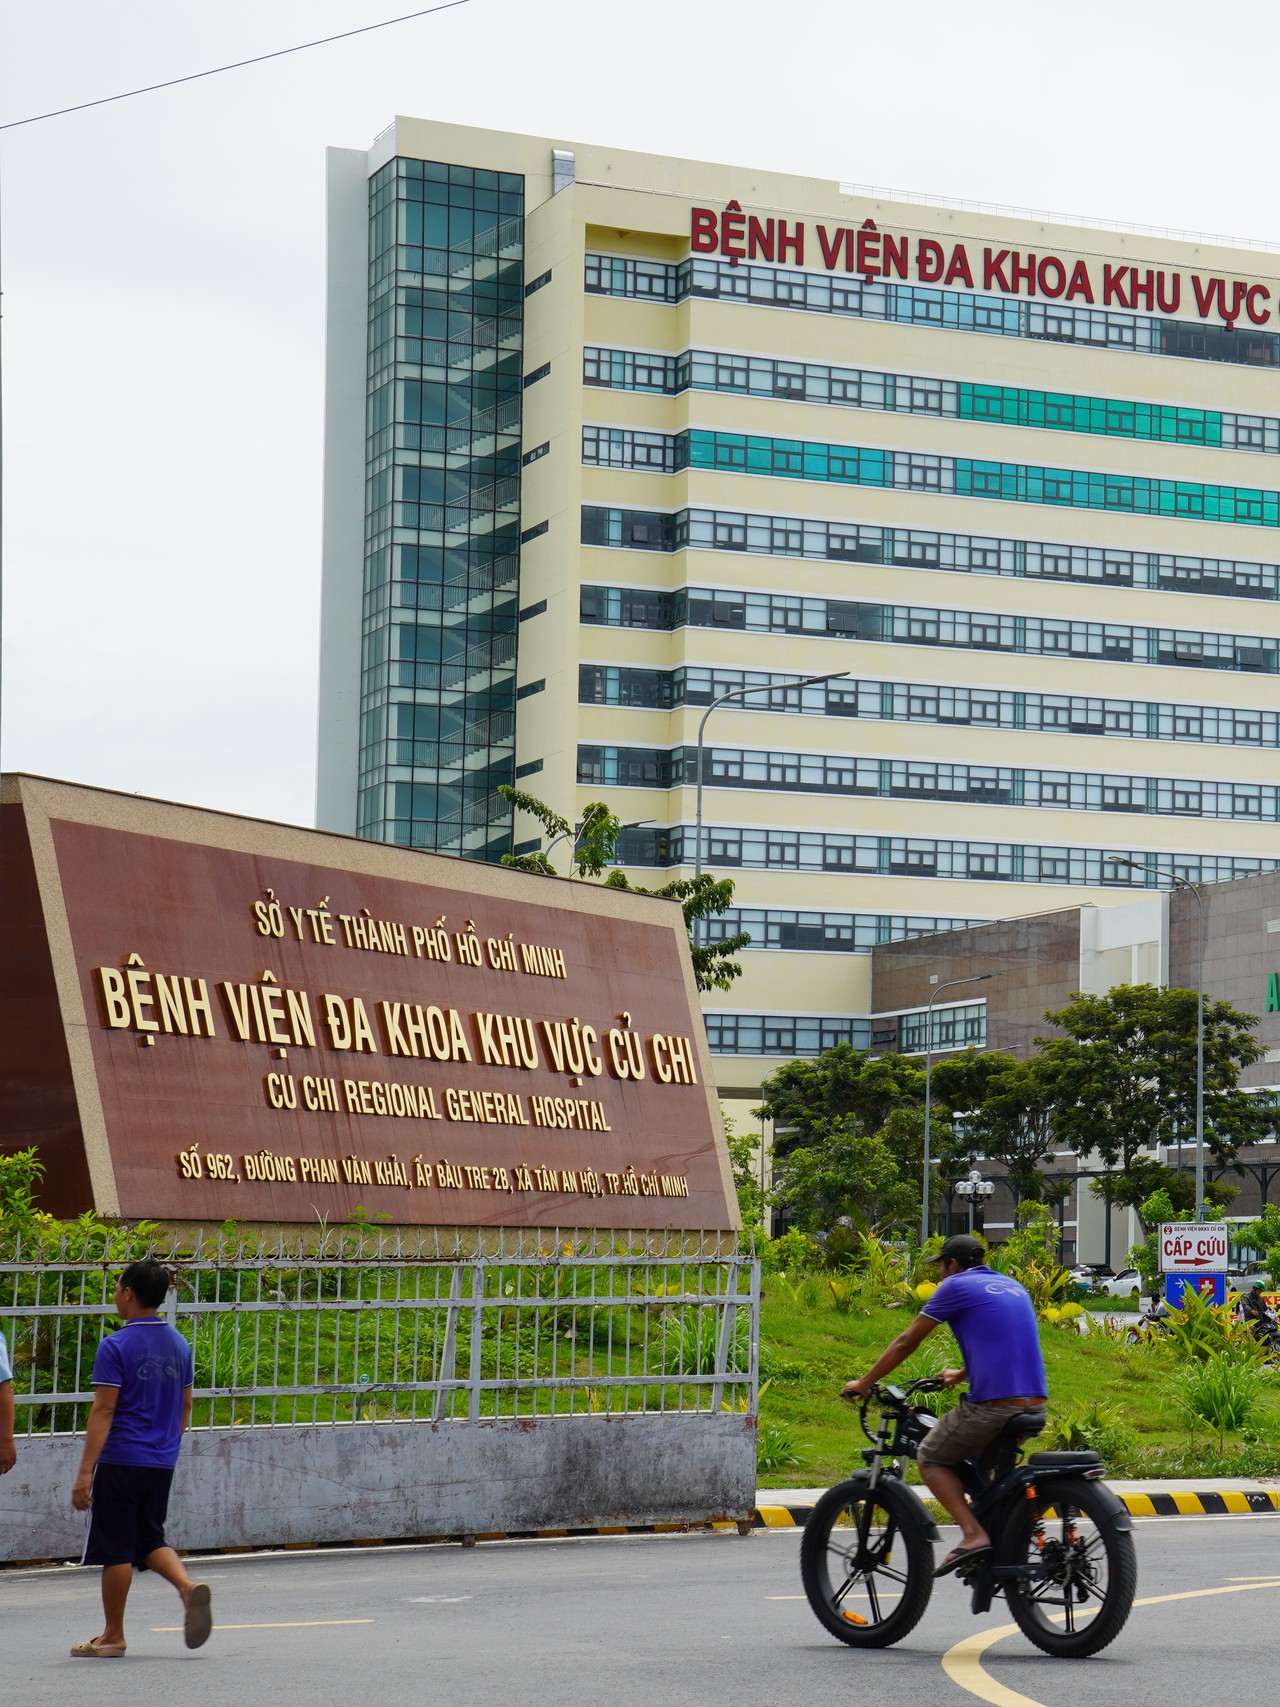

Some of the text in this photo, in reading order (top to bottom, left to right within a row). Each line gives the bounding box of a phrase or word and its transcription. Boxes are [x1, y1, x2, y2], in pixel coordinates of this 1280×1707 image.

[691, 200, 805, 268] BỆNH
[816, 219, 909, 285] VIỆN
[916, 238, 974, 289] ĐA
[983, 247, 1095, 304] KHOA
[1103, 263, 1181, 314] KHU
[1191, 275, 1272, 331] VỰC
[254, 888, 568, 979] SỞ Y TẾ THÀNH PHỐ HỒ CHÍ MINH
[100, 953, 698, 1087] BỆNH VIỆN ĐA KHOA KHU VỰC CỦ CHI
[1265, 972, 1280, 1013] A
[267, 1072, 612, 1132] CU CHI REGIONAL GENERAL HOSPITAL
[179, 1143, 202, 1180] SỐ
[206, 1152, 241, 1184] 962,
[244, 1150, 297, 1182] ĐƯỜNG
[300, 1157, 340, 1184] PHAN
[342, 1155, 372, 1186] VĂN
[374, 1154, 413, 1190] KHẢI,
[416, 1154, 433, 1188] ẤP
[436, 1159, 463, 1189] BÀU
[465, 1166, 491, 1190] TRE
[493, 1168, 514, 1194] 2B,
[515, 1163, 534, 1192] XÃ
[535, 1165, 559, 1193] TÂN
[562, 1170, 578, 1194] AN
[580, 1167, 604, 1199] HỘI,
[641, 1170, 661, 1197] CHÍ
[662, 1176, 690, 1198] MINH
[1164, 1234, 1226, 1257] CẤP CỨU
